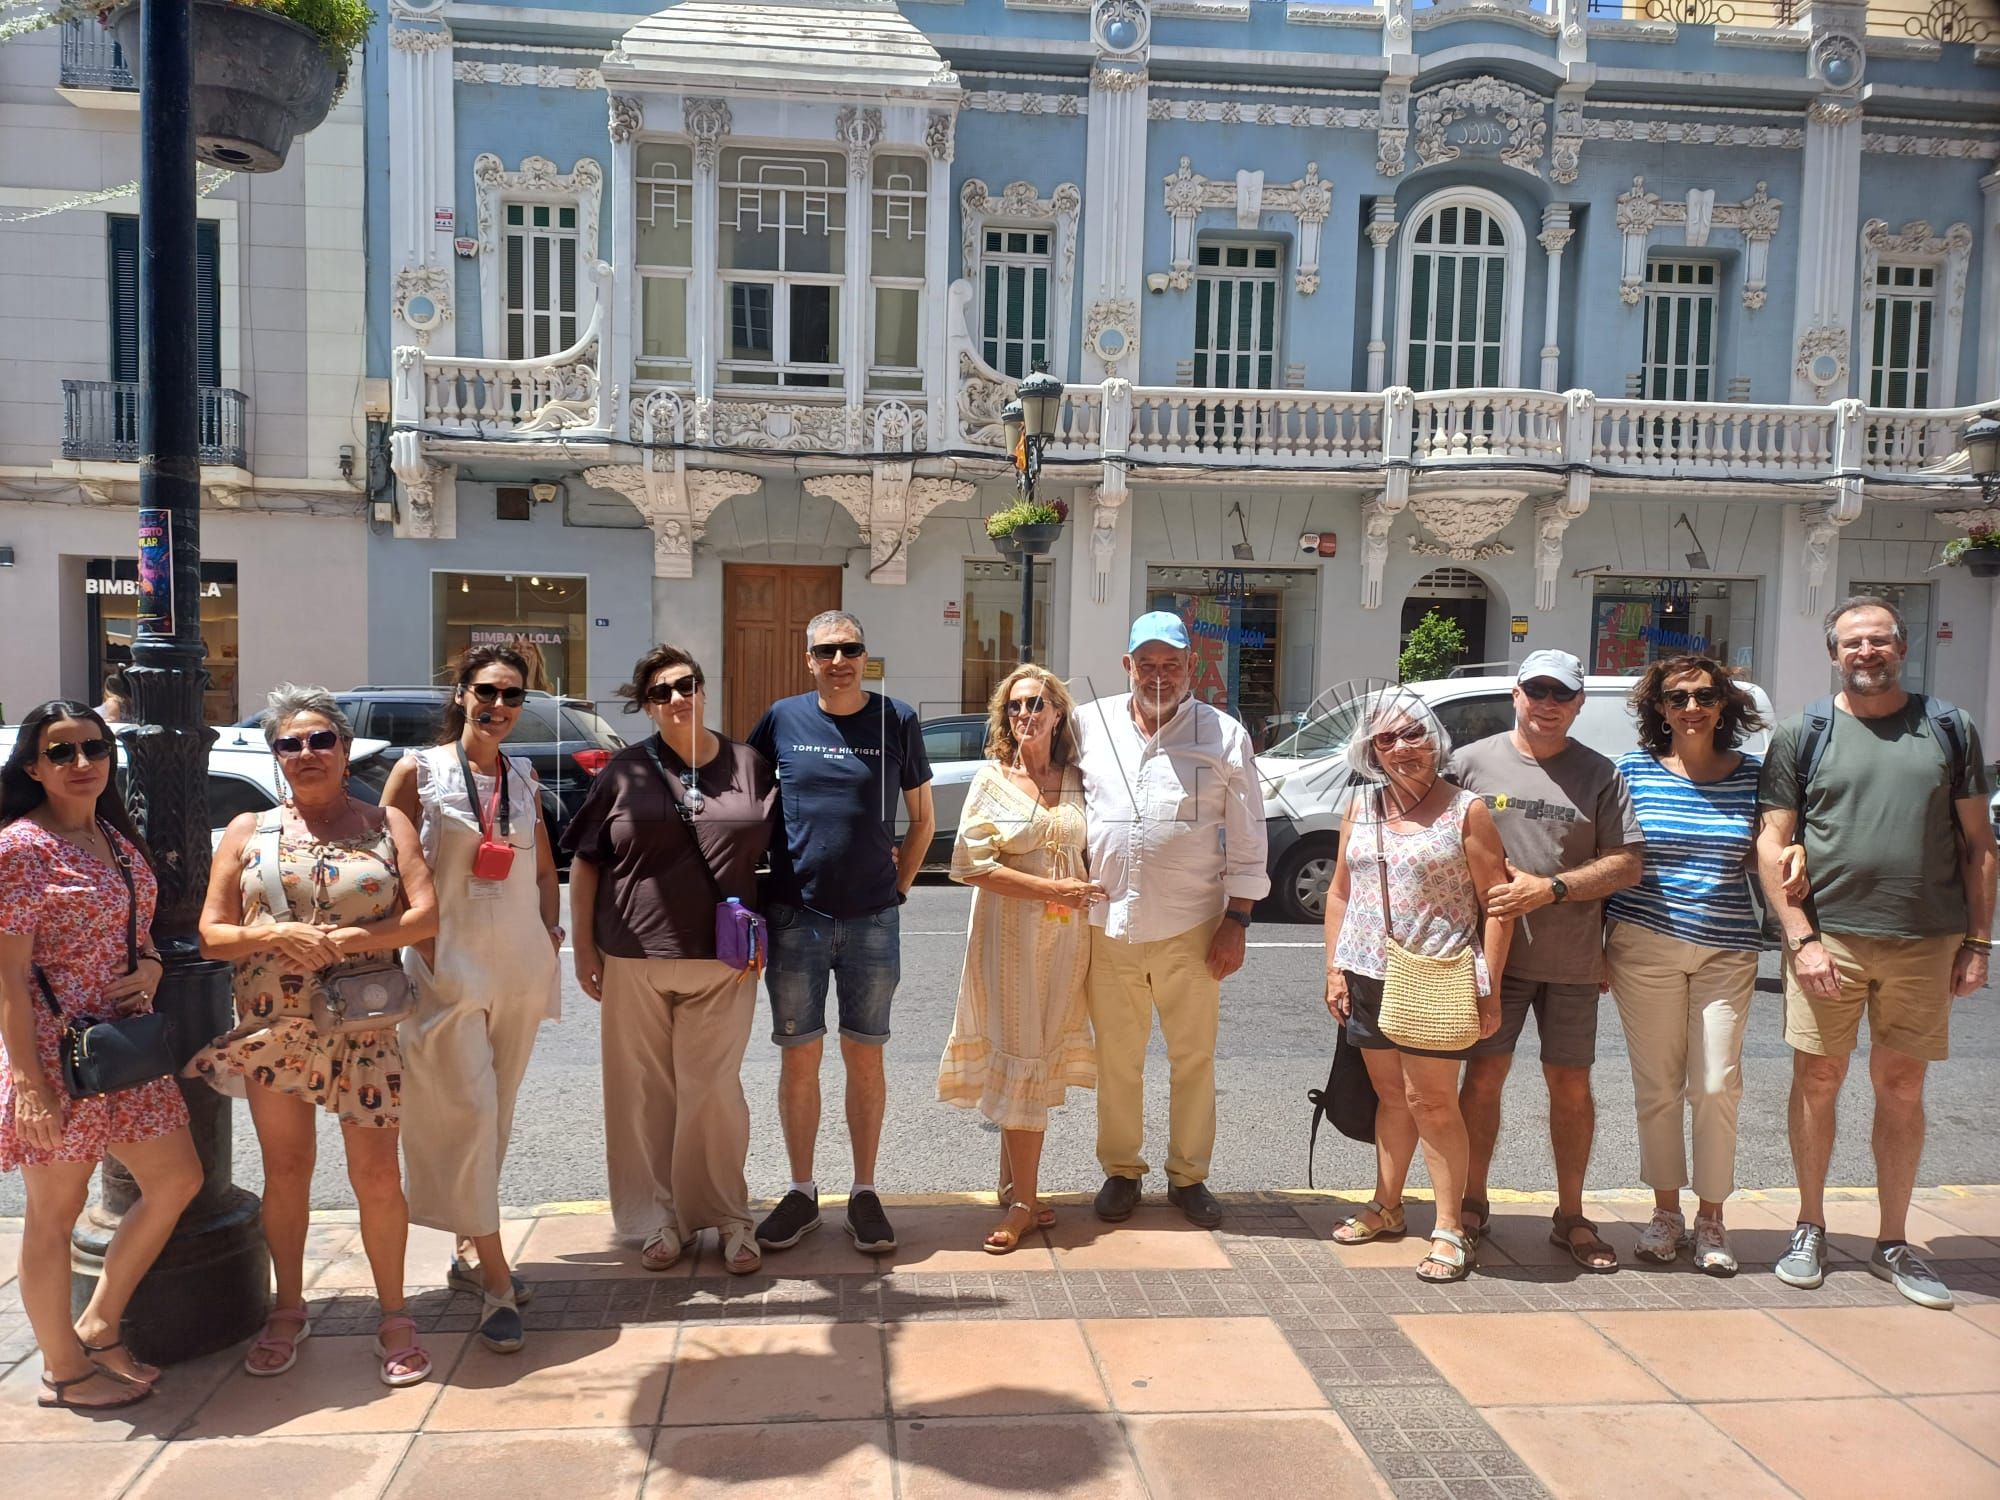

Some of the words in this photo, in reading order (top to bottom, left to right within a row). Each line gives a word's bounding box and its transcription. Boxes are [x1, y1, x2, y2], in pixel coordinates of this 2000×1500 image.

[85, 578, 139, 595] BIMB
[471, 631, 514, 643] BIMBA
[516, 632, 526, 643] Y
[529, 633, 562, 645] LOLA
[792, 744, 828, 753] TOMMY
[839, 747, 881, 756] HILFIGER
